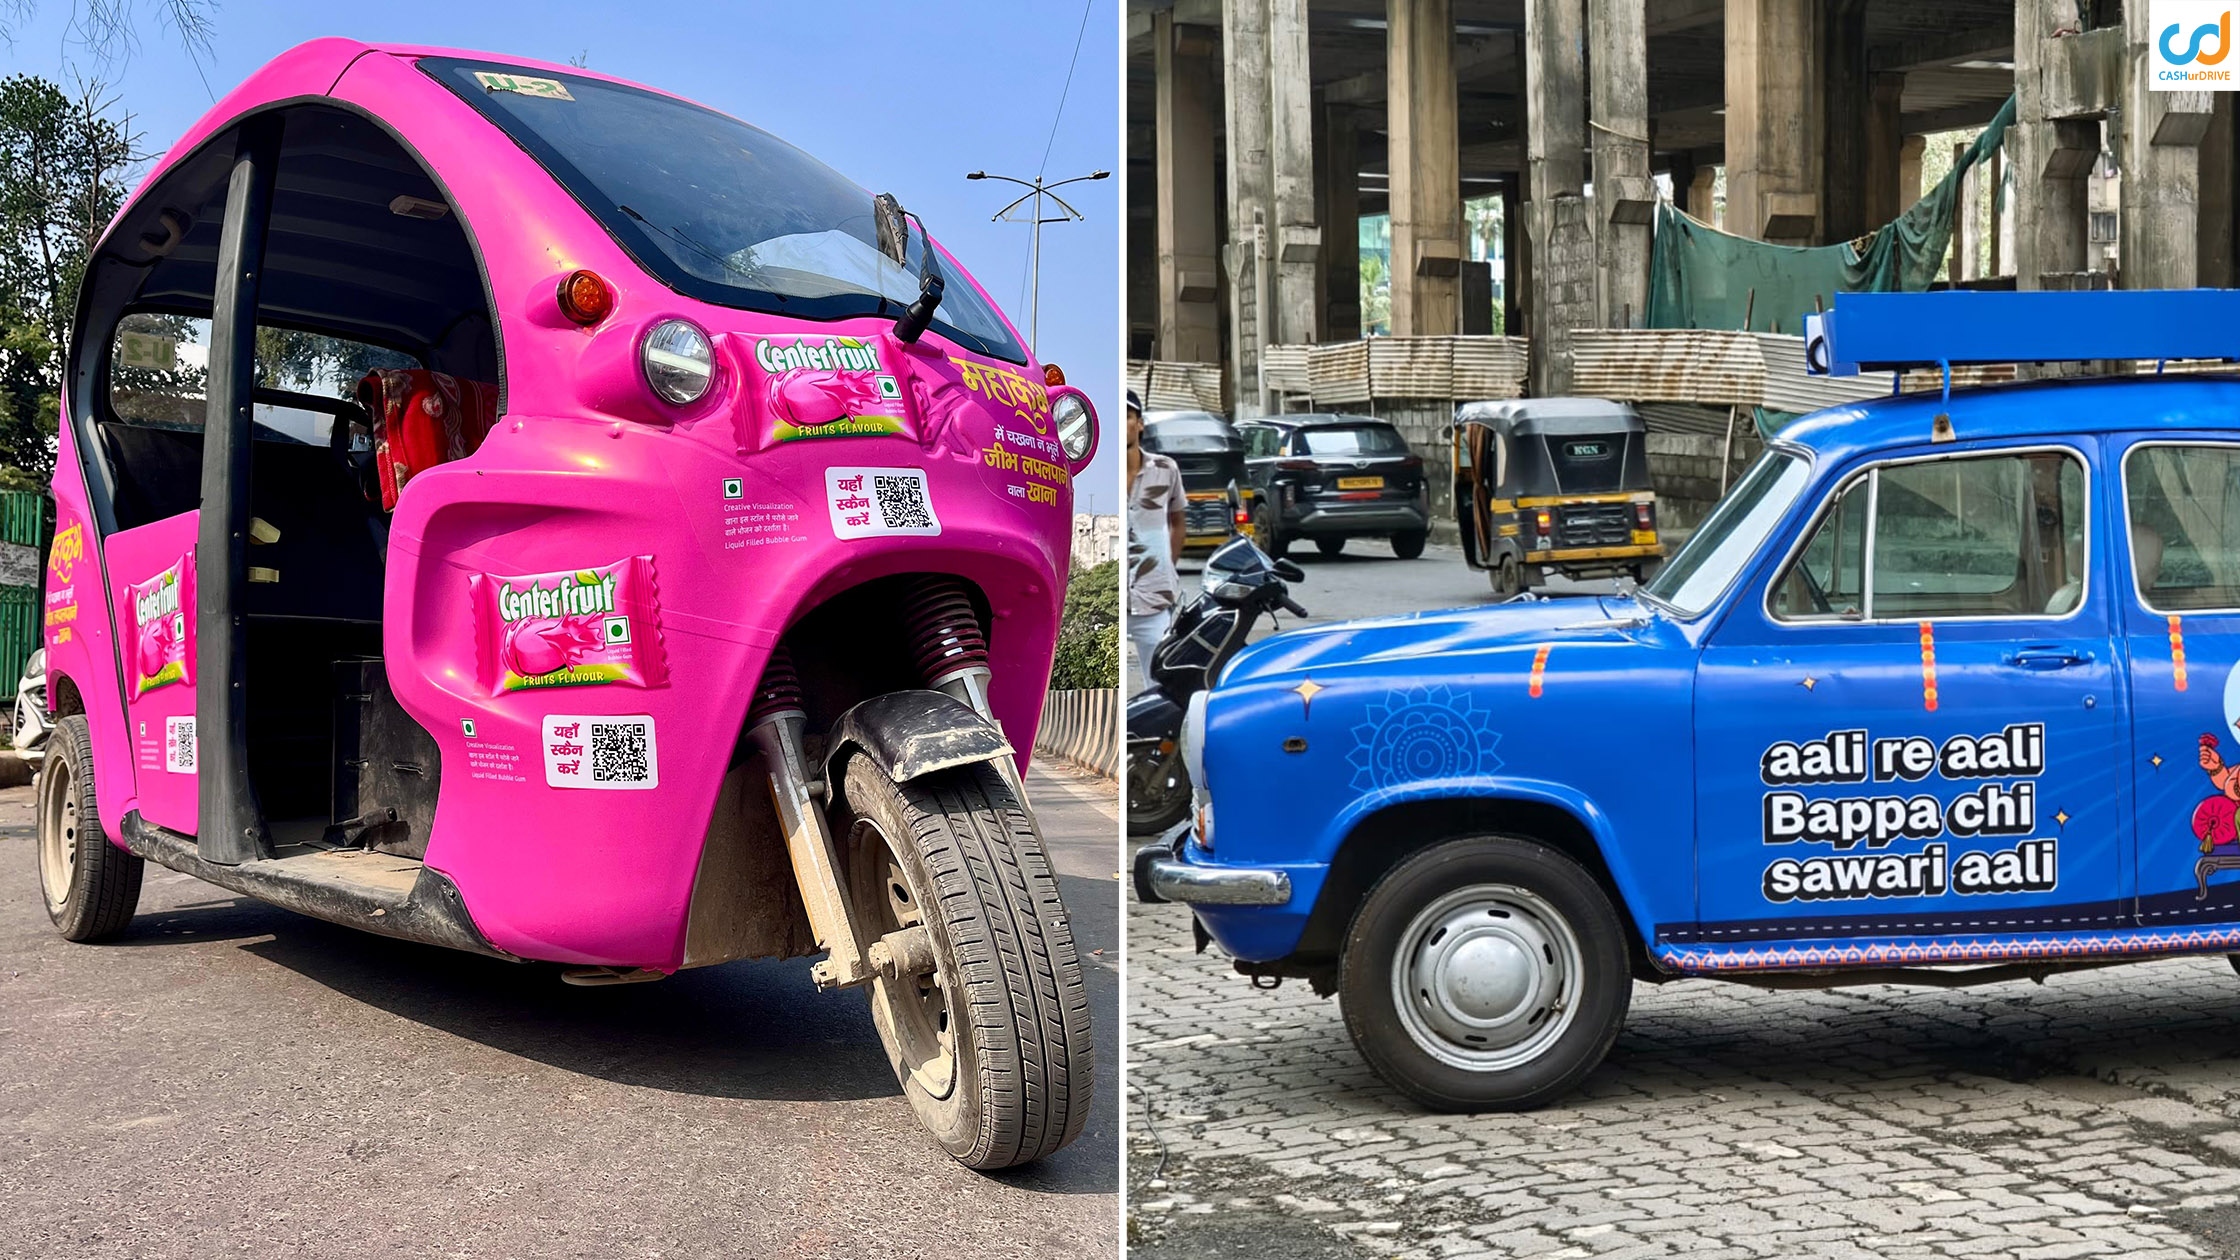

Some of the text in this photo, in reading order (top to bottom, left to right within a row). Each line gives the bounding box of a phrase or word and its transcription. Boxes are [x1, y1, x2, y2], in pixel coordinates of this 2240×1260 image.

[798, 423, 884, 437] FRUITS FLAVOUR
[993, 424, 1005, 442] में
[1006, 430, 1036, 449] चखना
[1037, 438, 1046, 452] न
[982, 442, 1069, 489] जीभ लपलपाने
[837, 475, 864, 492] यहाँ
[1007, 481, 1058, 507] वाला खाना
[724, 503, 751, 512] Creative
[836, 494, 870, 511] स्कैन
[845, 512, 870, 526] करें
[725, 540, 744, 550] Liquid
[746, 538, 764, 546] Filled
[765, 536, 789, 545] Bubble
[523, 671, 604, 686] FRUITS FLAVOUR
[554, 722, 580, 738] यहाँ
[550, 741, 583, 757] स्कैन
[1765, 725, 2042, 781] aali re aali
[557, 759, 580, 775] करें
[1767, 784, 2033, 845] Bappa chi
[1767, 841, 2055, 898] sawari aali
